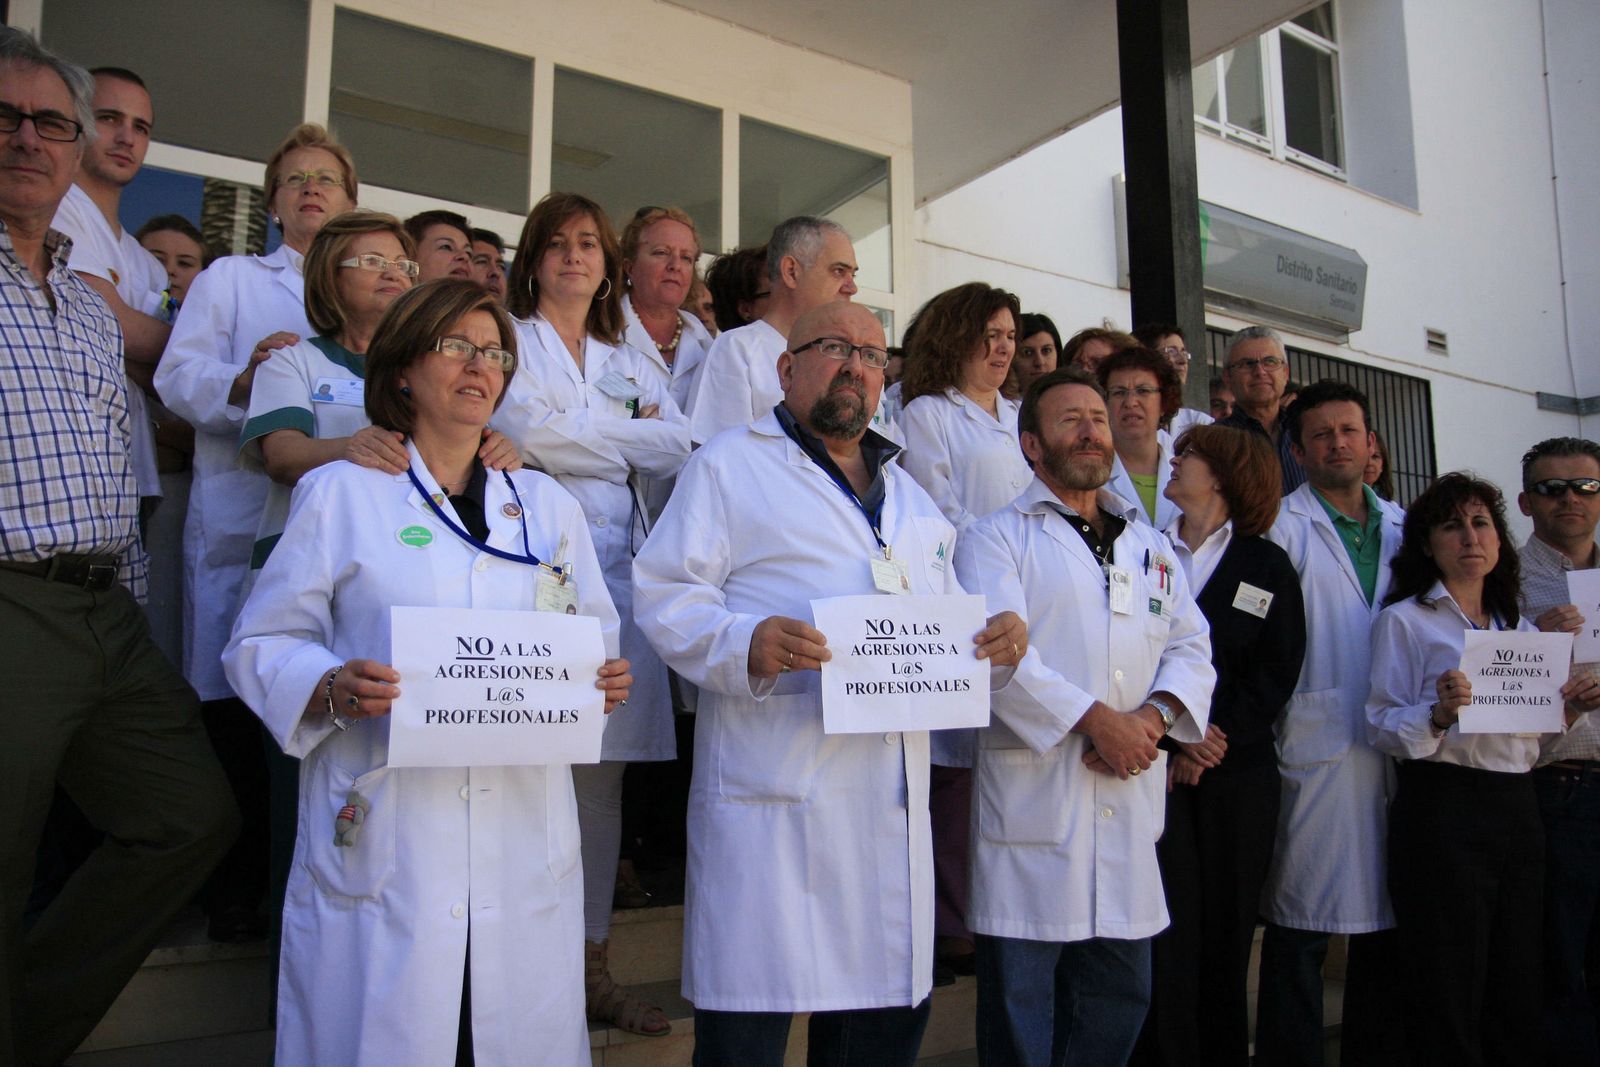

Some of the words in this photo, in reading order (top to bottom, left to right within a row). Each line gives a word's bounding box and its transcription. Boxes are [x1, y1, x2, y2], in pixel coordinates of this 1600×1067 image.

[1276, 254, 1313, 282] Distrito
[1316, 265, 1358, 295] Sanitario
[865, 618, 895, 636] NO
[899, 624, 909, 635] A
[913, 623, 941, 636] LAS
[456, 636, 494, 657] NO
[500, 643, 512, 656] A
[518, 643, 552, 657] LAS
[850, 643, 945, 656] AGRESIONES
[949, 643, 959, 655] A
[1493, 649, 1514, 662] NO
[1515, 653, 1522, 662] A
[1524, 653, 1544, 663] LAS
[434, 664, 554, 681] AGRESIONES
[558, 668, 570, 681] A
[891, 662, 923, 678] L@S
[1478, 667, 1542, 678] AGRESIONES
[1543, 668, 1551, 678] A
[845, 679, 970, 695] PROFESIONALES
[1502, 681, 1523, 693] L@S
[486, 687, 525, 705] L@S
[1472, 694, 1552, 706] PROFESIONALES
[425, 709, 579, 724] PROFESIONALES
